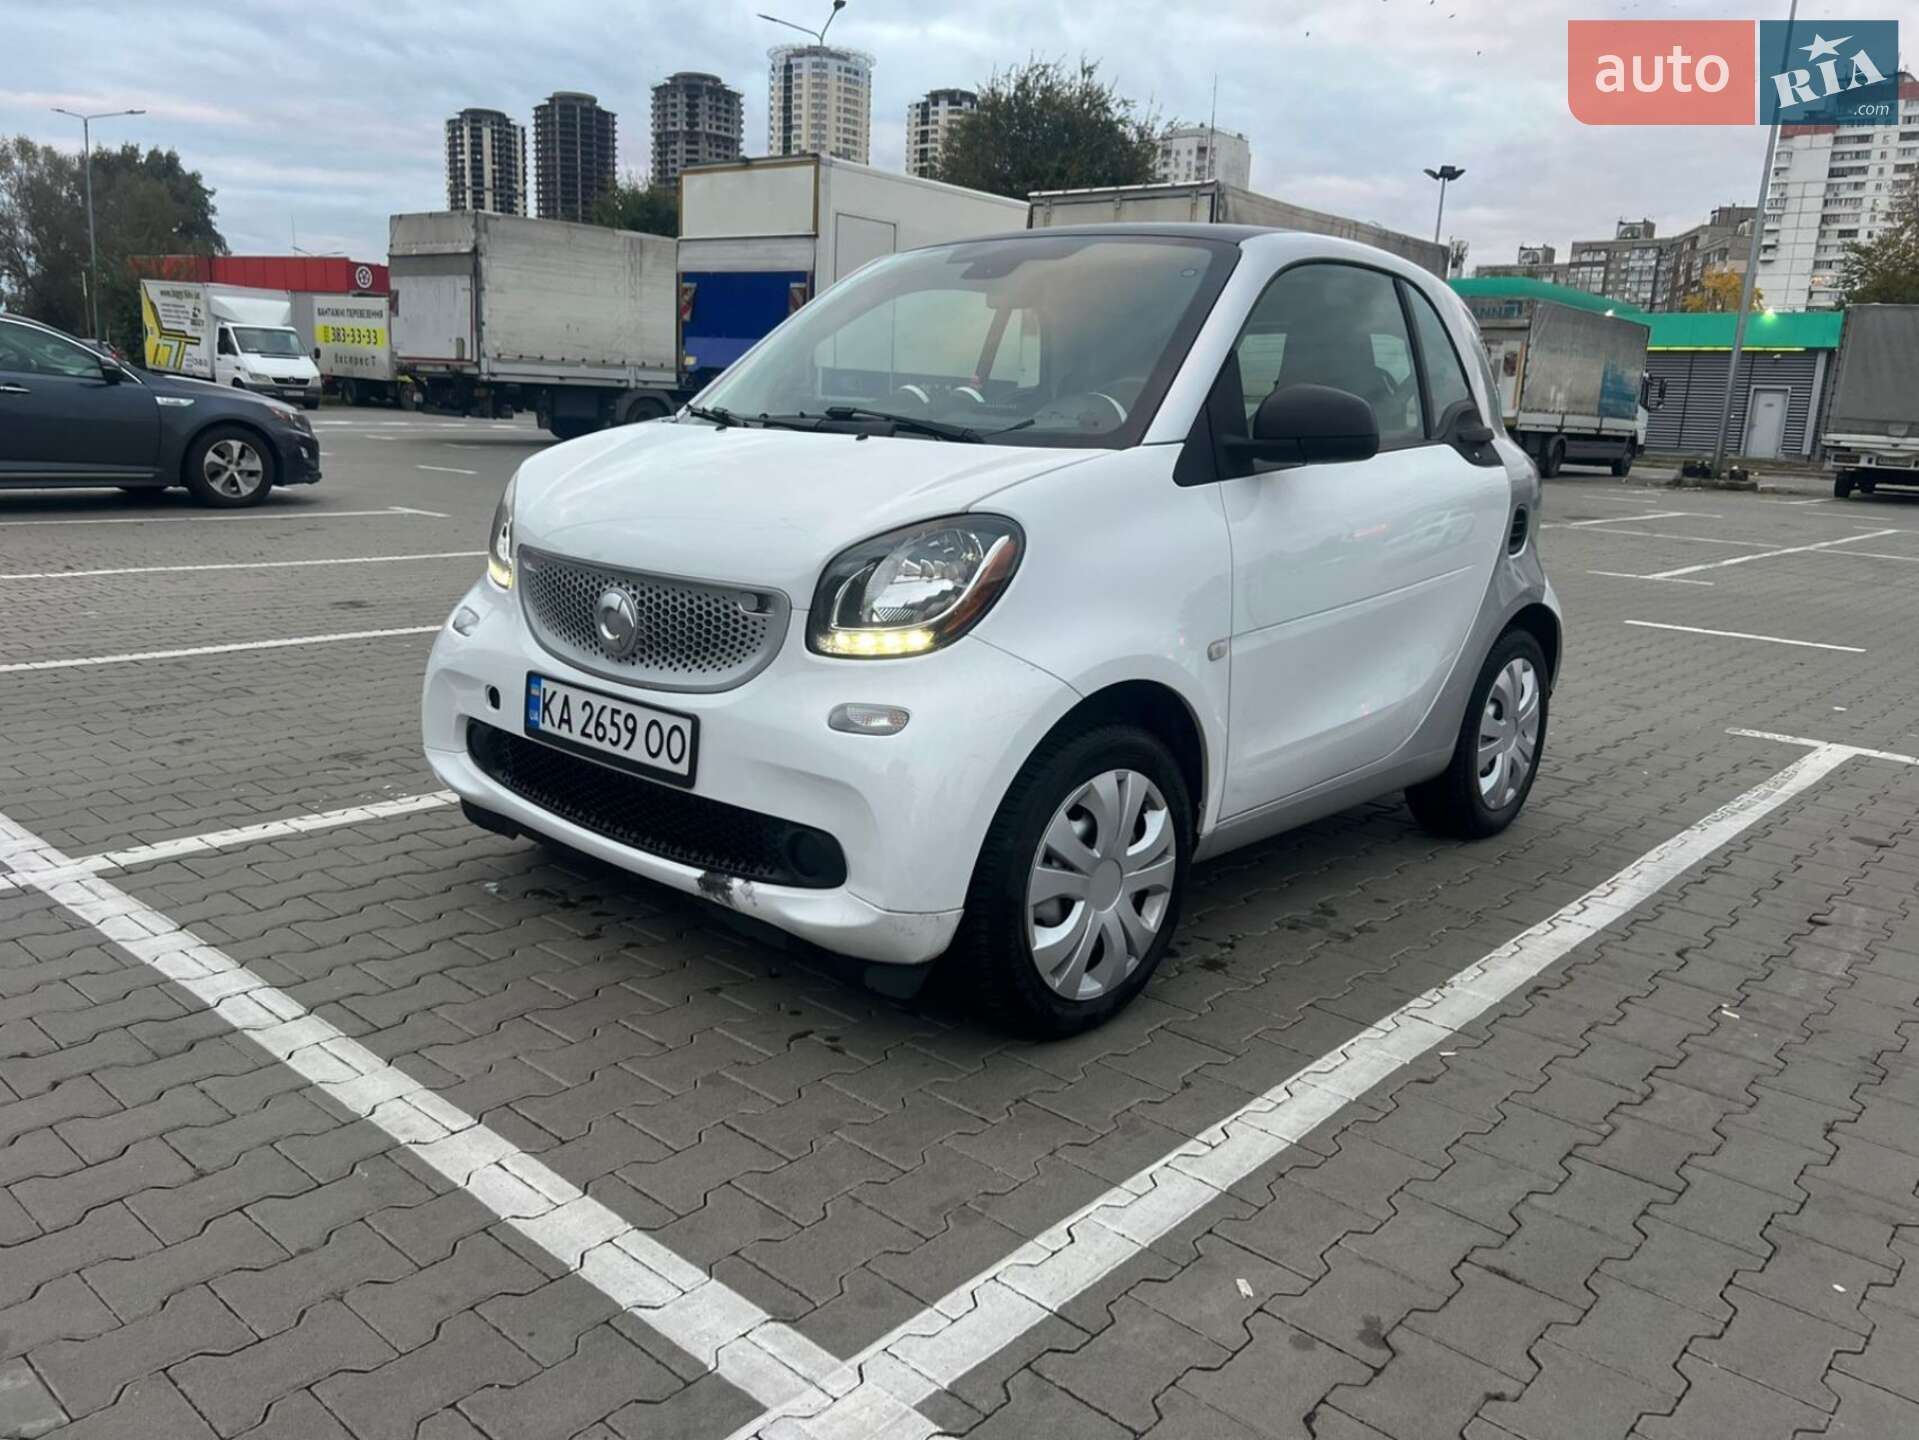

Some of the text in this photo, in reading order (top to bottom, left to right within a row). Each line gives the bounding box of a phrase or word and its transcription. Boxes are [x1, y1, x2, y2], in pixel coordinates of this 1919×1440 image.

[331, 326, 378, 345] 383-33-33
[541, 687, 686, 765] KA 2659 OO
